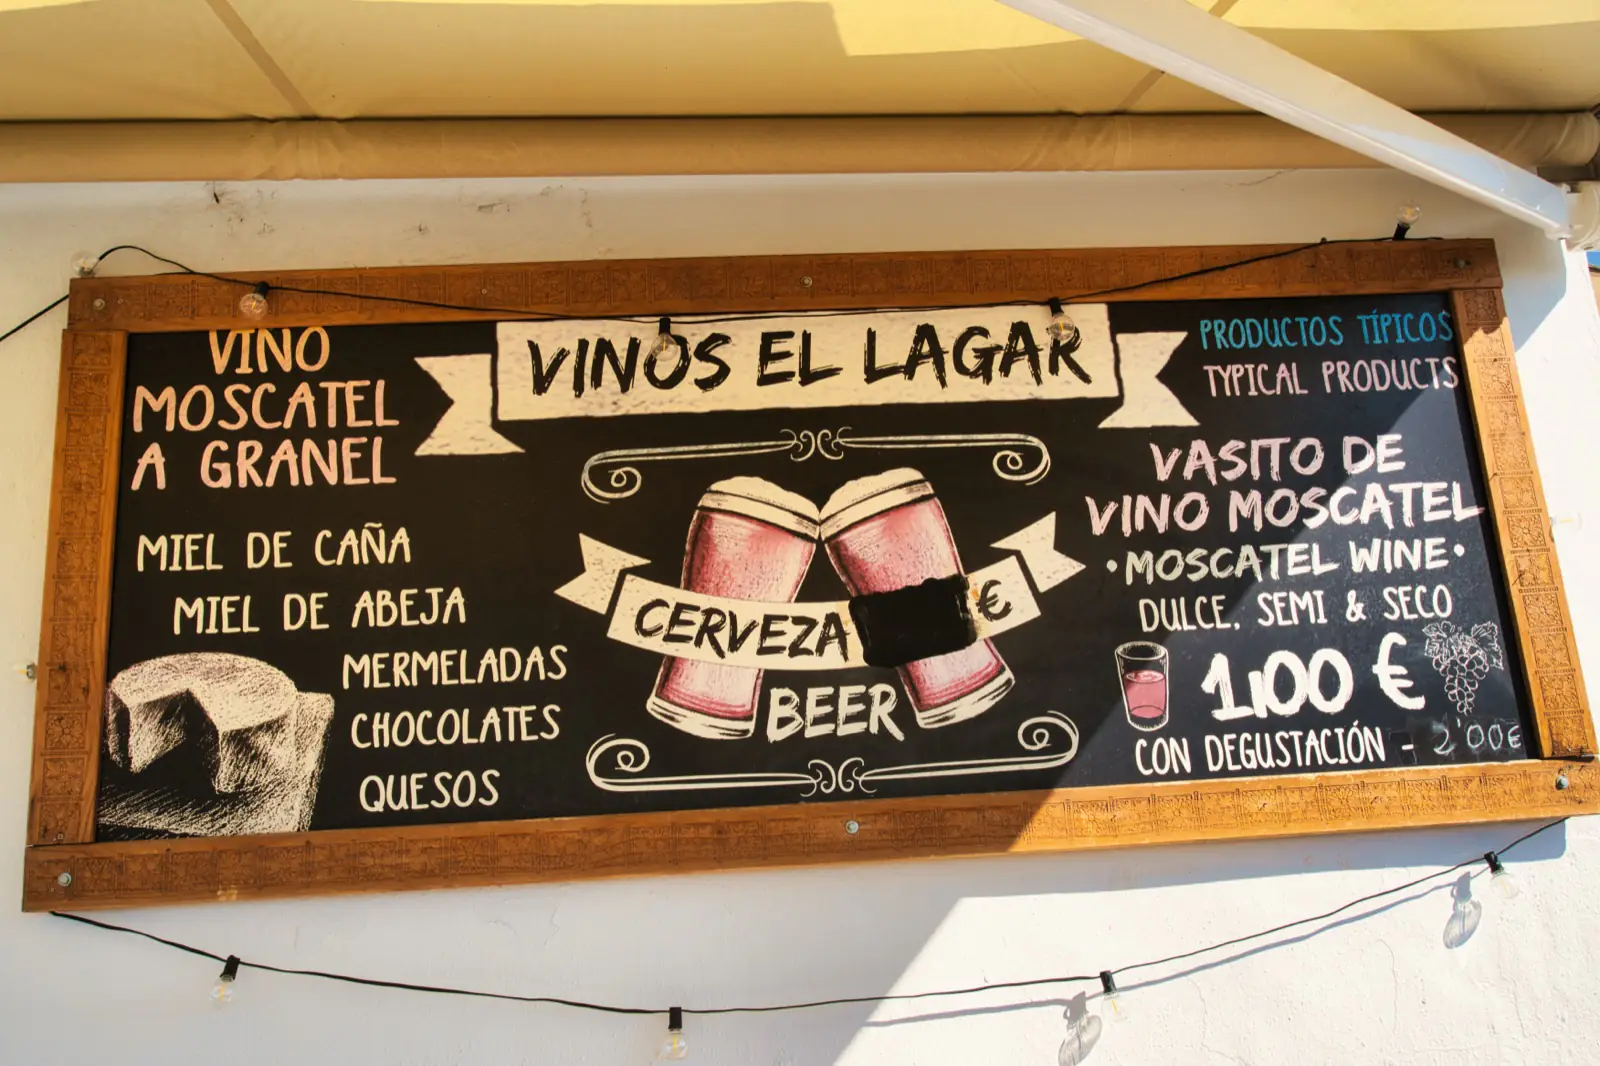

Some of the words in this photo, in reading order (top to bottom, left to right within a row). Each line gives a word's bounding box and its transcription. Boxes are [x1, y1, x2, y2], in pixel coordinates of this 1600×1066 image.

[208, 326, 330, 375] VINO
[1199, 315, 1344, 350] PRODUCTOS
[1356, 308, 1455, 345] TÍPICOS
[527, 331, 732, 396] VINOS
[756, 329, 843, 387] EL
[863, 320, 1093, 389] LAGAR
[1203, 362, 1309, 397] TYPICAL
[1321, 356, 1460, 393] PRODUCTS
[132, 379, 400, 433] MOSCATEL
[130, 442, 167, 491] A
[199, 436, 398, 489] GRANEL
[1148, 436, 1325, 486] VASITO
[1342, 433, 1407, 476] DE
[1084, 494, 1211, 537] VINO
[1228, 480, 1485, 532] MOSCATEL
[136, 533, 224, 573] MIEL
[246, 530, 294, 569] DE
[314, 522, 412, 567] CAÑA
[173, 596, 261, 636] MIEL
[282, 593, 330, 631] DE
[351, 586, 467, 629] ABEJA
[633, 598, 851, 663] CERVEZA
[1256, 590, 1328, 627] SEMI
[1346, 593, 1365, 623] &
[1382, 585, 1453, 620] SECO
[342, 644, 569, 691] MERMELADAS
[1371, 631, 1426, 711] €
[350, 704, 562, 749] CHOCOLATES
[765, 683, 906, 744] BEER
[1134, 736, 1193, 777] CON
[1204, 720, 1386, 773] DEGUSTACIÓN
[358, 768, 501, 813] QUESOS
